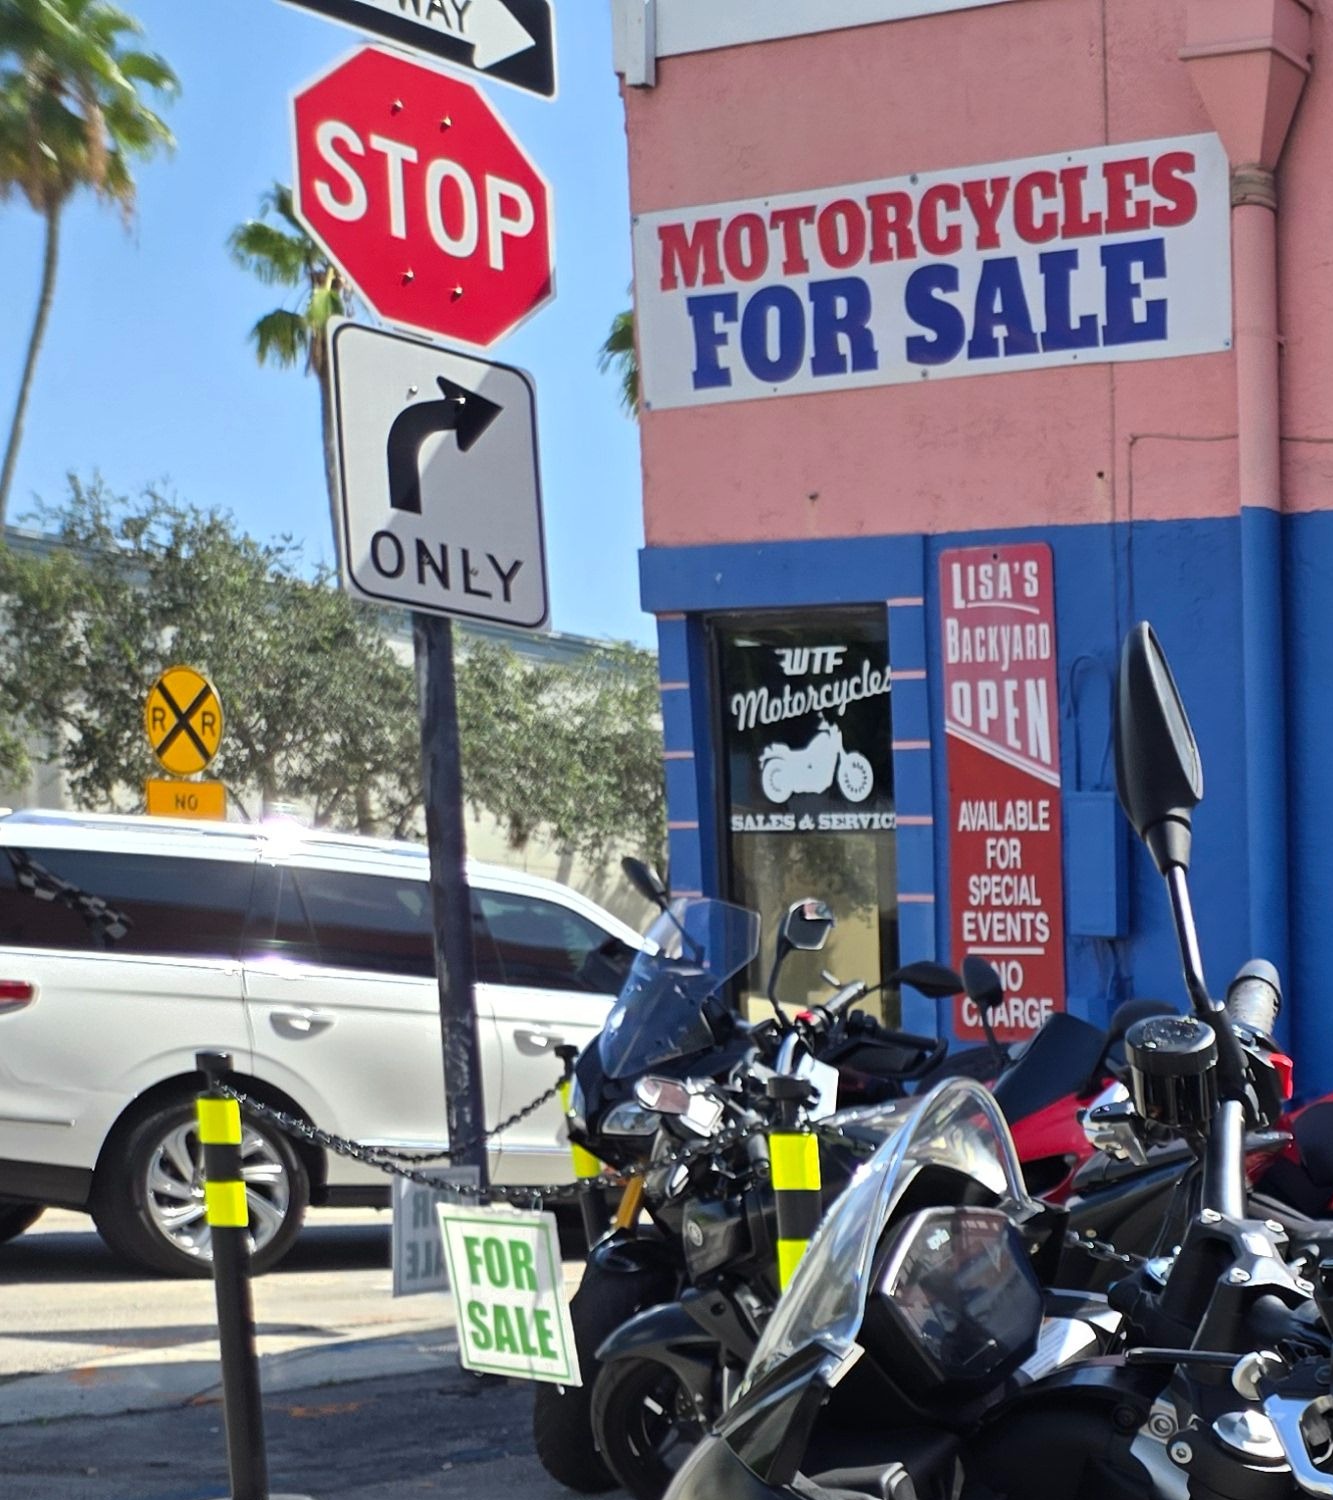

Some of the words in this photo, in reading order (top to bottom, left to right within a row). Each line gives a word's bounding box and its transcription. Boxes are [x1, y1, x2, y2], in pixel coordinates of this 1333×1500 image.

[313, 120, 534, 271] STOP
[658, 151, 1197, 291] MOTORCYCLES
[686, 275, 879, 391] FOR
[904, 237, 1169, 366] SALE
[370, 529, 524, 603] ONLY
[952, 560, 1040, 609] LISA'S
[775, 646, 848, 675] WTF
[945, 619, 1051, 671] BACKYARD
[731, 659, 892, 732] Motorcycles
[951, 677, 1053, 765] OPEN
[174, 793, 198, 811] NO
[730, 813, 796, 832] SALES
[798, 812, 815, 830] &
[818, 812, 896, 830] SERVIC
[958, 800, 1050, 832] AVAILABLE
[986, 838, 1021, 869] FOR
[968, 874, 1041, 906] SPECIAL
[962, 911, 1050, 943] EVENTS
[463, 1235, 537, 1292] FOR
[467, 1300, 559, 1360] SALE
